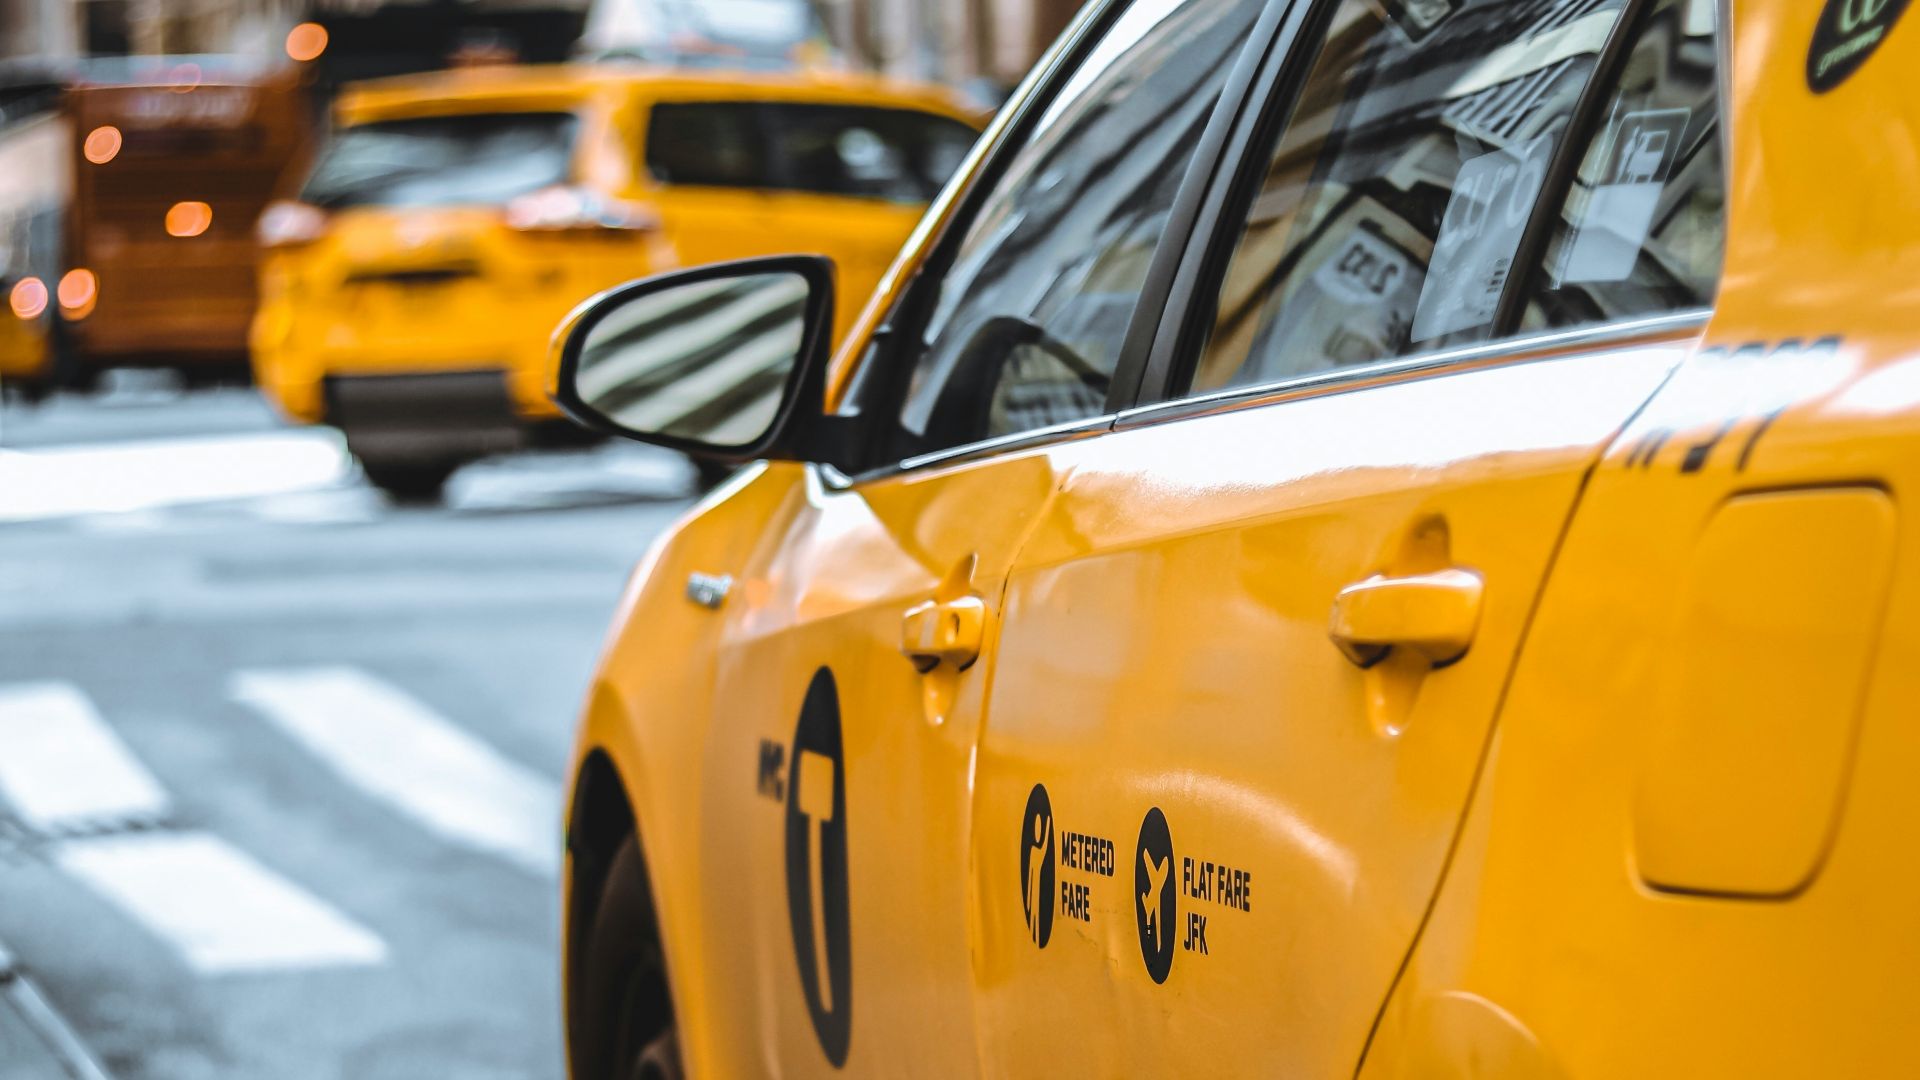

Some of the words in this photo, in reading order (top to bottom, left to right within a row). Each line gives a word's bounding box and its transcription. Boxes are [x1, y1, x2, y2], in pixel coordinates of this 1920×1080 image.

[1061, 830, 1115, 877] METERED
[1061, 881, 1091, 922] FARE
[1183, 856, 1214, 902] FLAT
[1217, 865, 1251, 913] FARE
[1183, 912, 1208, 955] JFK
